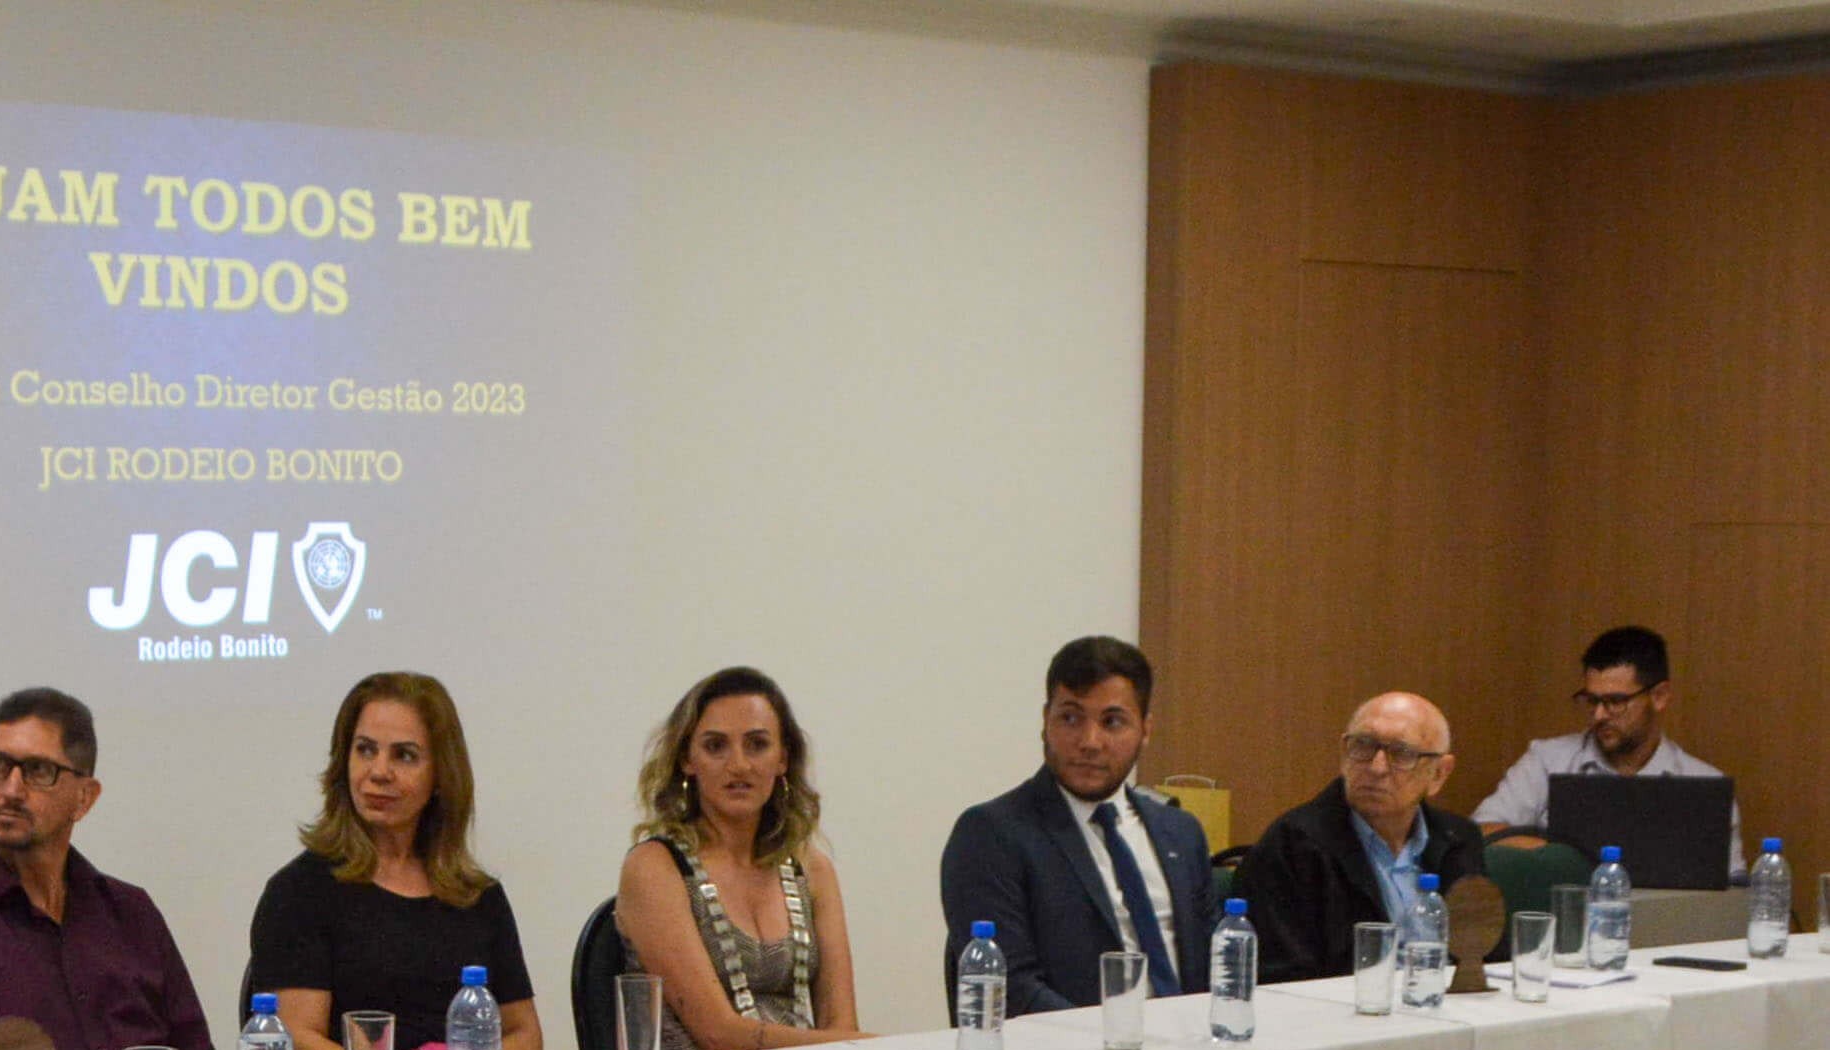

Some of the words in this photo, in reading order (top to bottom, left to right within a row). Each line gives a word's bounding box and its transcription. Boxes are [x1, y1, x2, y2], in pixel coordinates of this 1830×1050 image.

[145, 176, 377, 243] TODOS
[398, 194, 532, 250] BEM
[90, 252, 350, 315] VINDOS
[9, 369, 186, 407] Conselho
[196, 374, 319, 411] Diretor
[329, 379, 447, 414] Gestão
[453, 382, 527, 415] 2023
[40, 446, 97, 492] JCI
[108, 447, 257, 482] RODEIO
[268, 449, 404, 484] BONITO
[87, 530, 278, 630] JCI
[138, 636, 213, 661] Rodeio
[220, 634, 289, 658] Bonito
